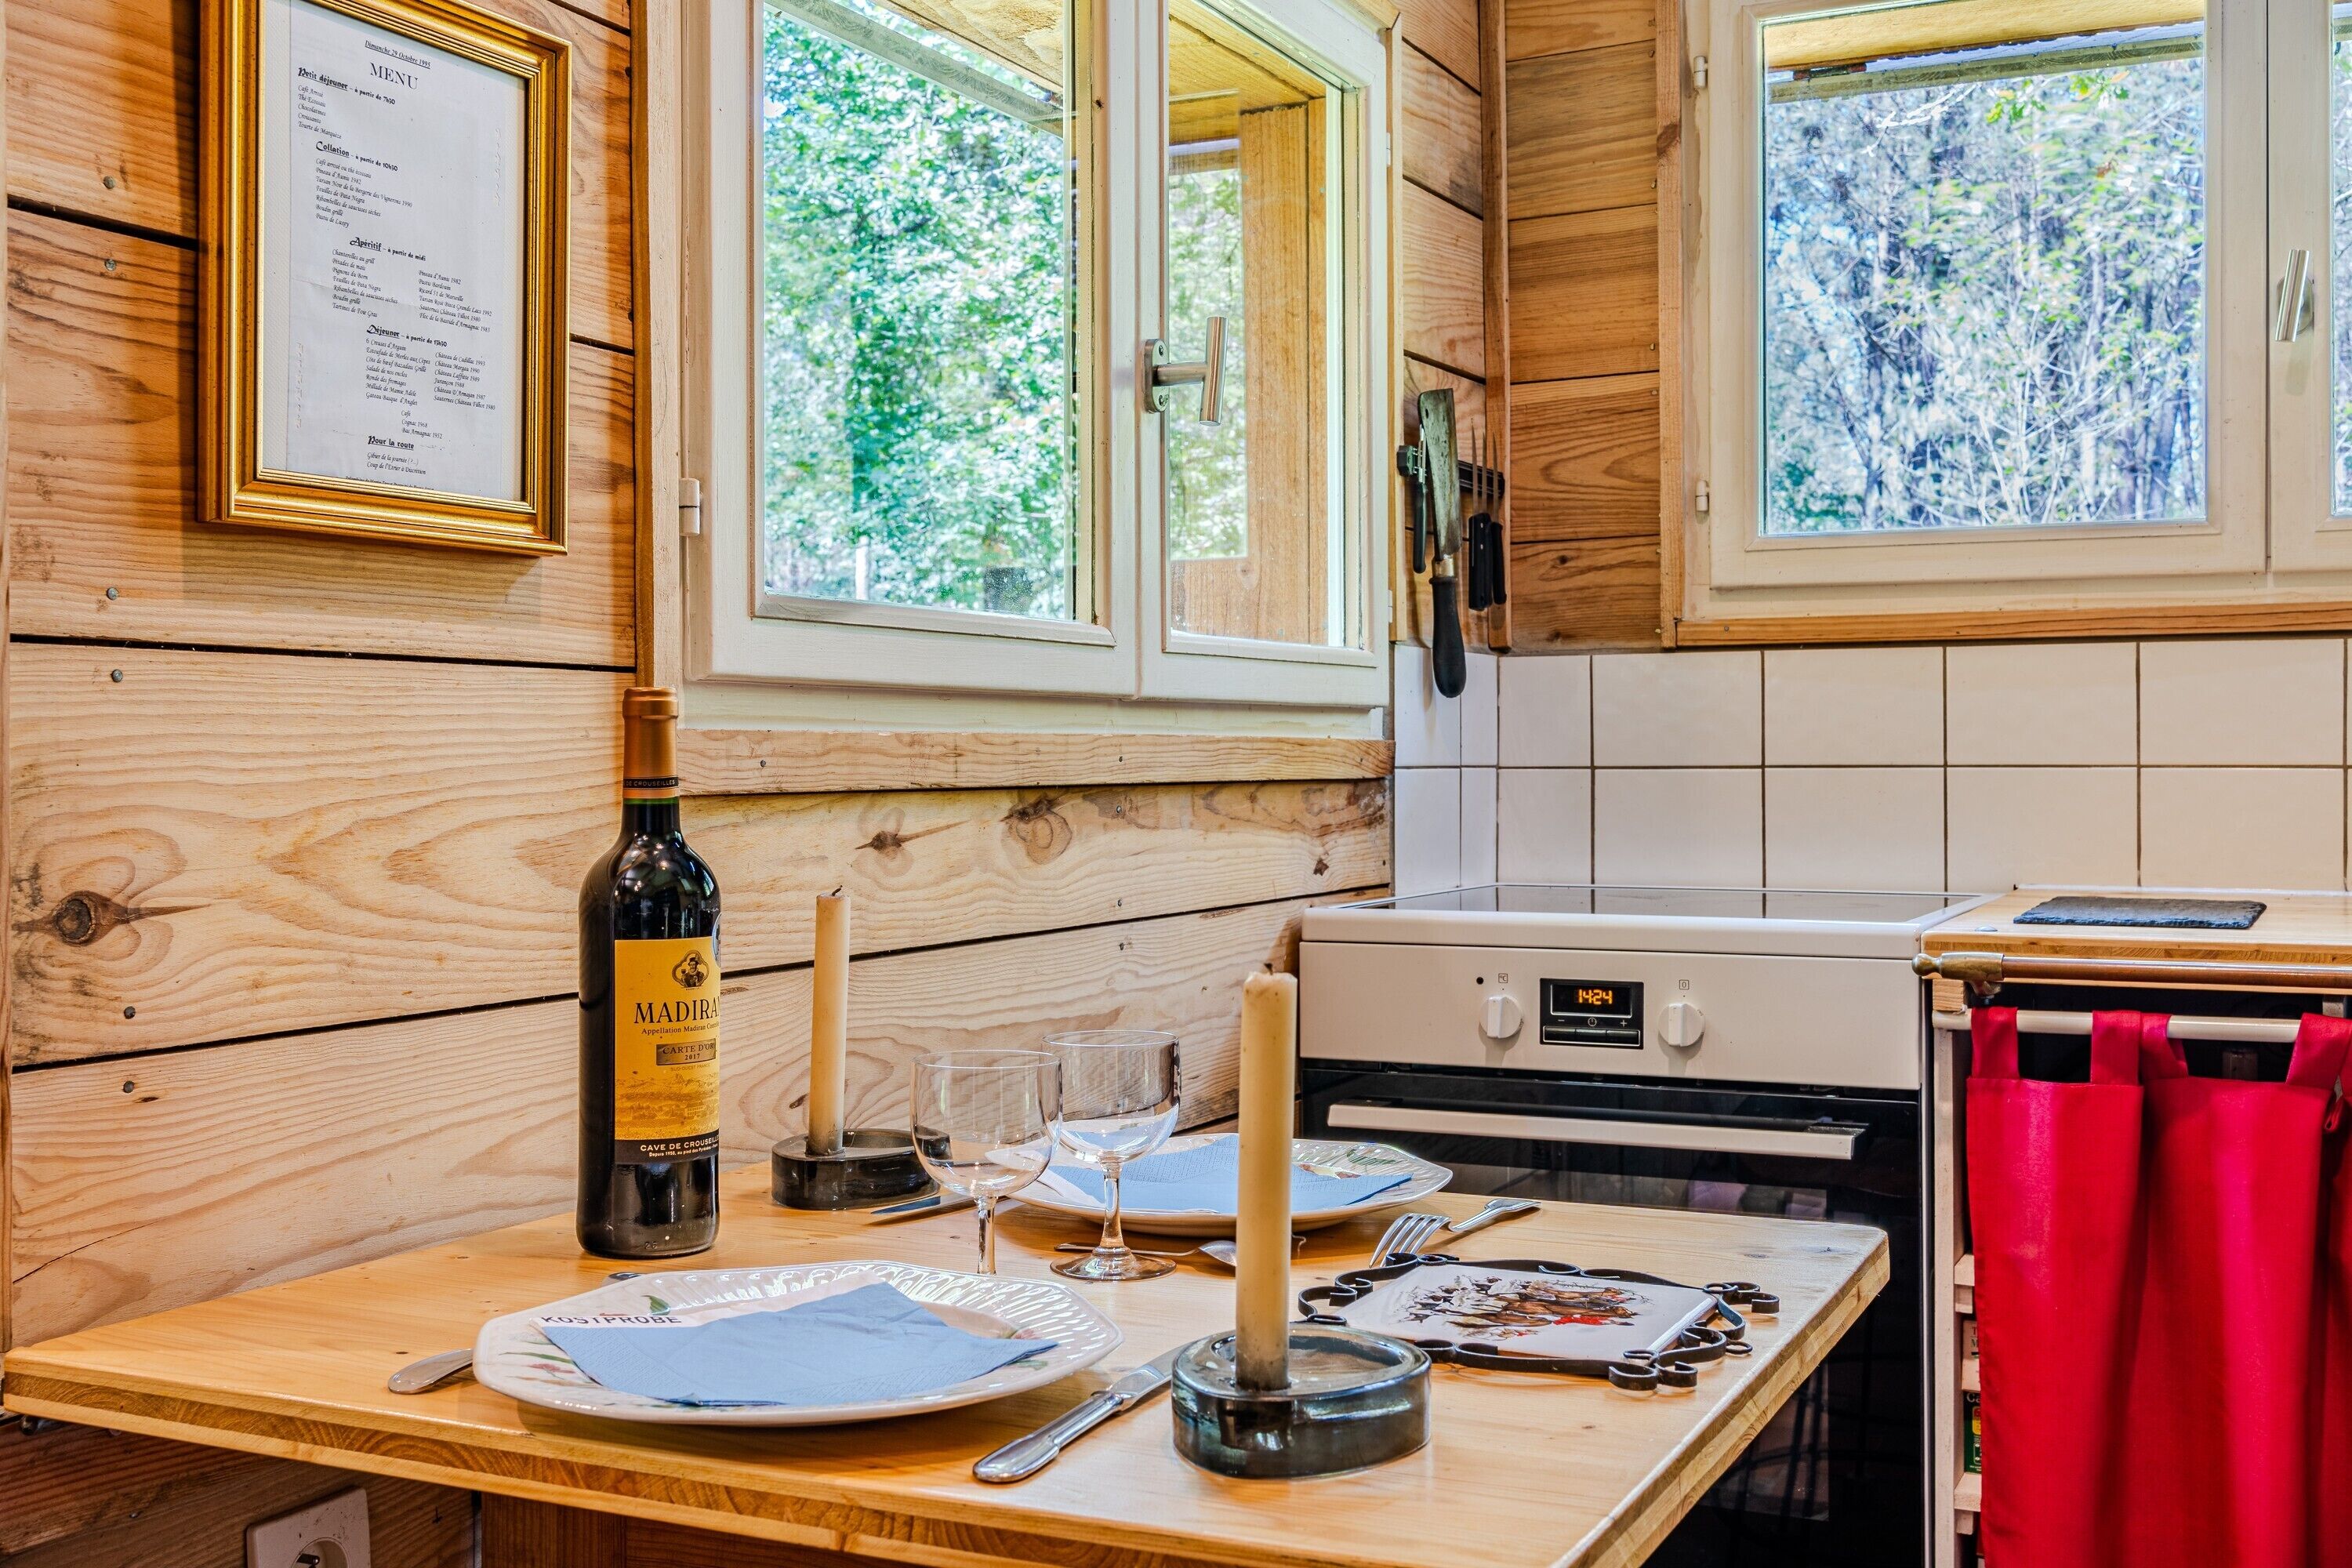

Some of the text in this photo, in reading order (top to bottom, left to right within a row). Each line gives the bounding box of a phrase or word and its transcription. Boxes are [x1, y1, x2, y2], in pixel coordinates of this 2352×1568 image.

[365, 41, 390, 54] Dimanche
[399, 52, 418, 63] Octobre
[419, 59, 430, 68] 1995
[370, 62, 419, 89] MENU
[298, 67, 317, 79] Petit
[319, 74, 348, 89] déjeuner
[360, 89, 375, 99] partir
[298, 122, 313, 131] Tourte
[316, 141, 350, 157] Collation
[361, 157, 375, 165] partir
[316, 158, 326, 167] Café
[351, 176, 361, 185] 1982
[352, 195, 365, 205] Negra
[350, 237, 382, 251] Apéritif
[332, 249, 358, 260] Chanterelles
[366, 324, 400, 336] Déjeuner
[365, 365, 380, 373] Salade
[387, 377, 407, 387] fromages
[401, 419, 416, 428] Cognac
[368, 435, 386, 445] Pour
[397, 441, 414, 450] route
[366, 462, 378, 470] Coup
[641, 1026, 682, 1036] Appellation
[684, 1024, 706, 1033] Madiran
[662, 1045, 696, 1054] CARTE
